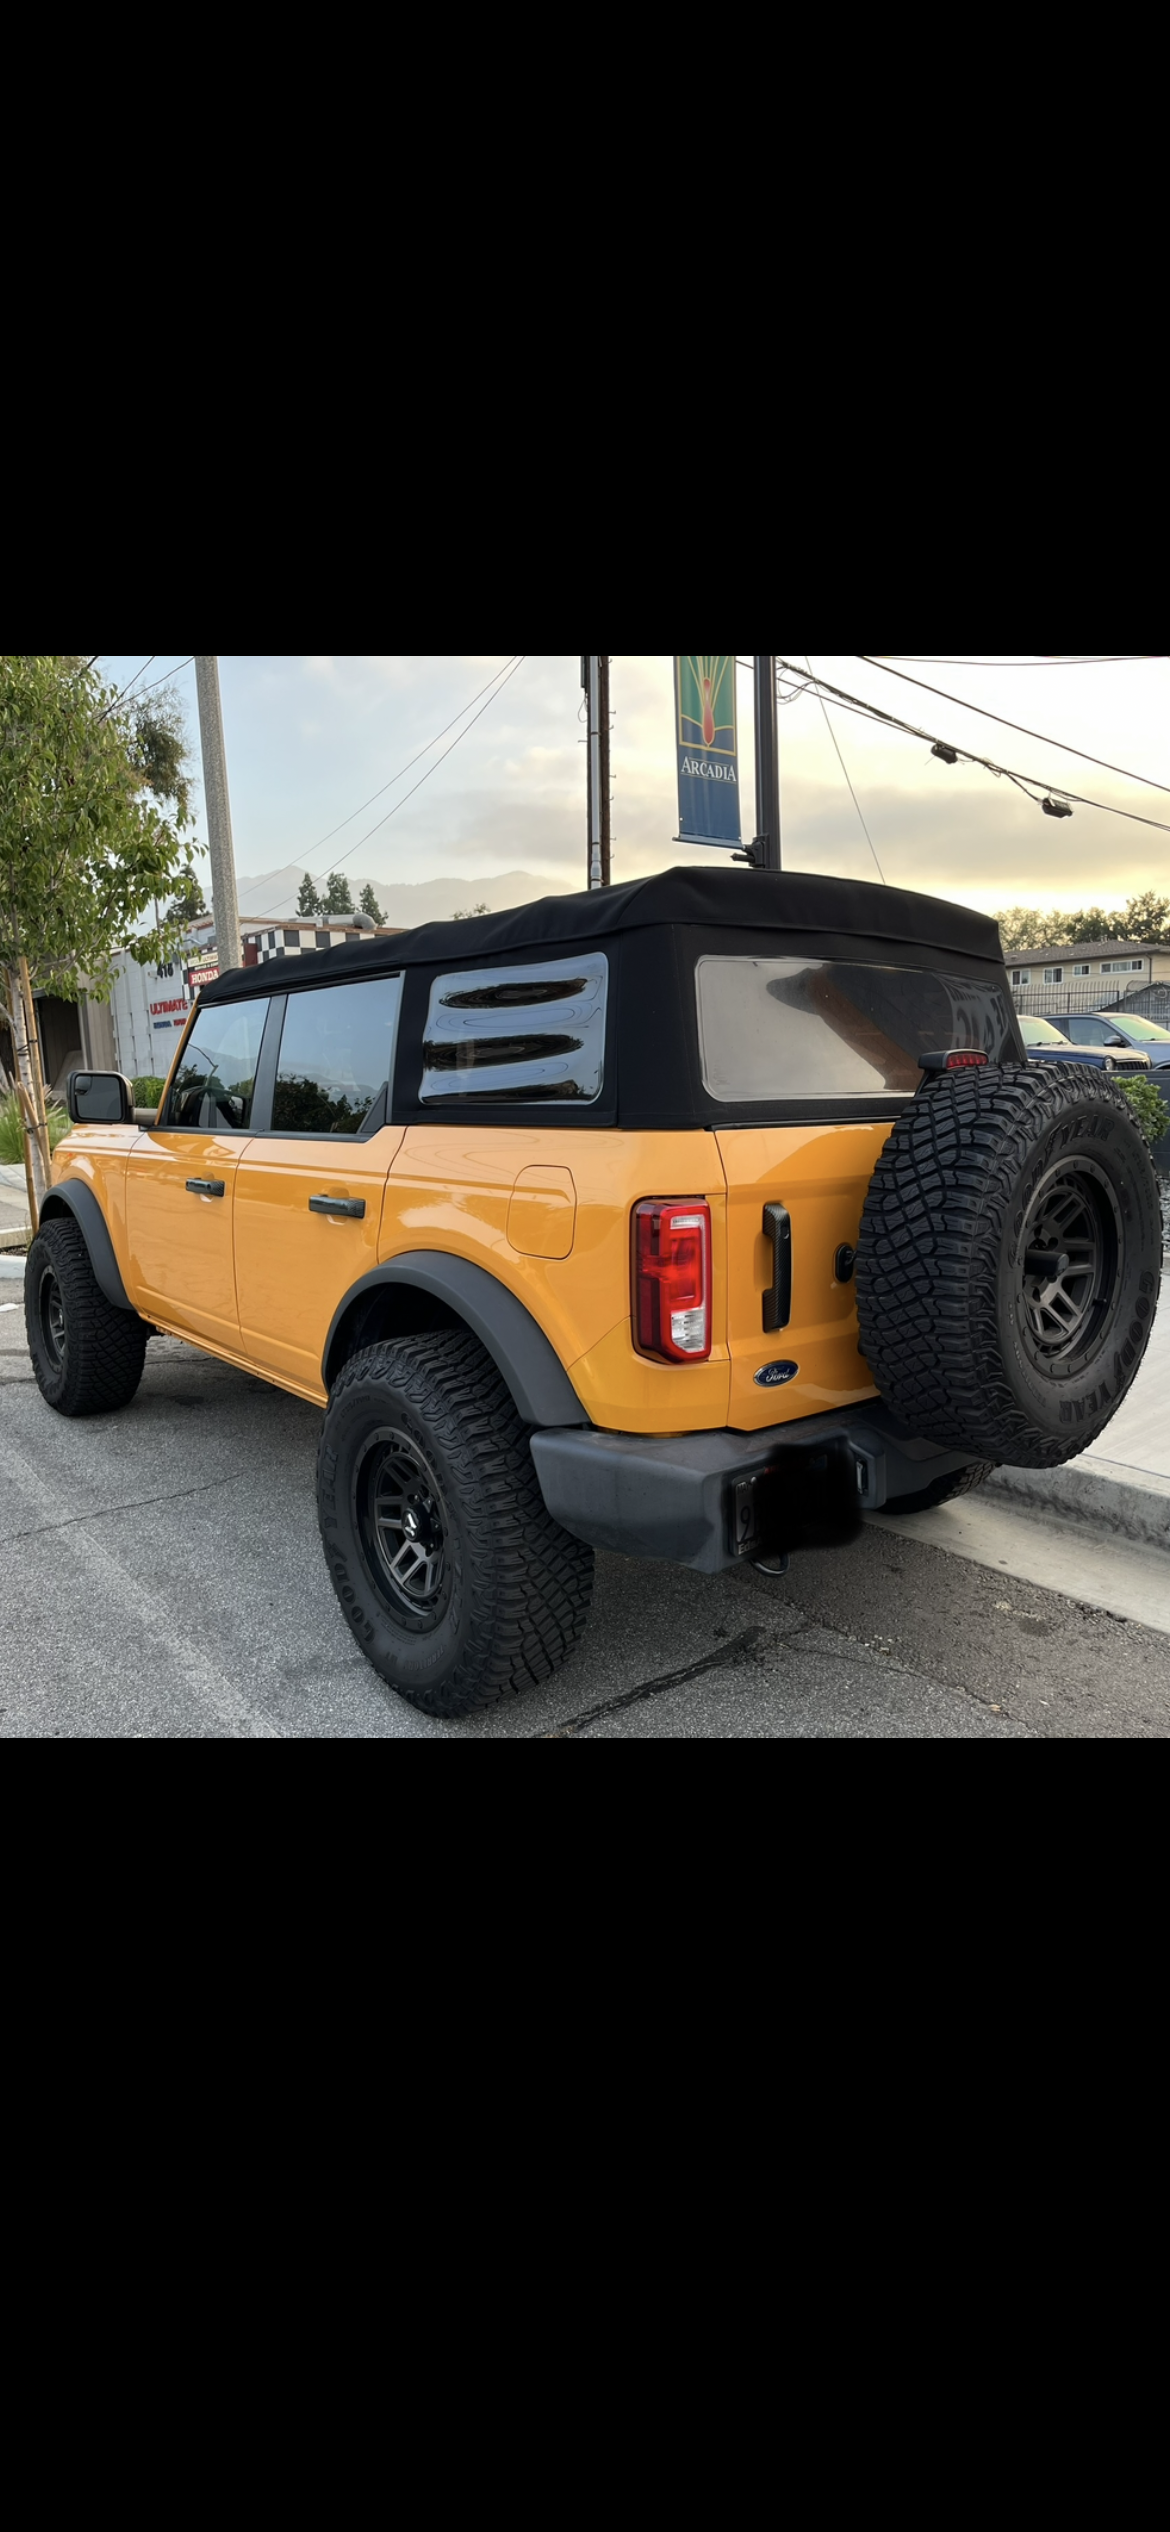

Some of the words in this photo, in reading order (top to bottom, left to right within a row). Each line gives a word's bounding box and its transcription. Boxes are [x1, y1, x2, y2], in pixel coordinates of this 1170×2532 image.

[681, 756, 737, 782] ARCADIA
[191, 969, 219, 984] HONDA
[150, 999, 188, 1016] ULTIMATE
[765, 1367, 791, 1383] Ford
